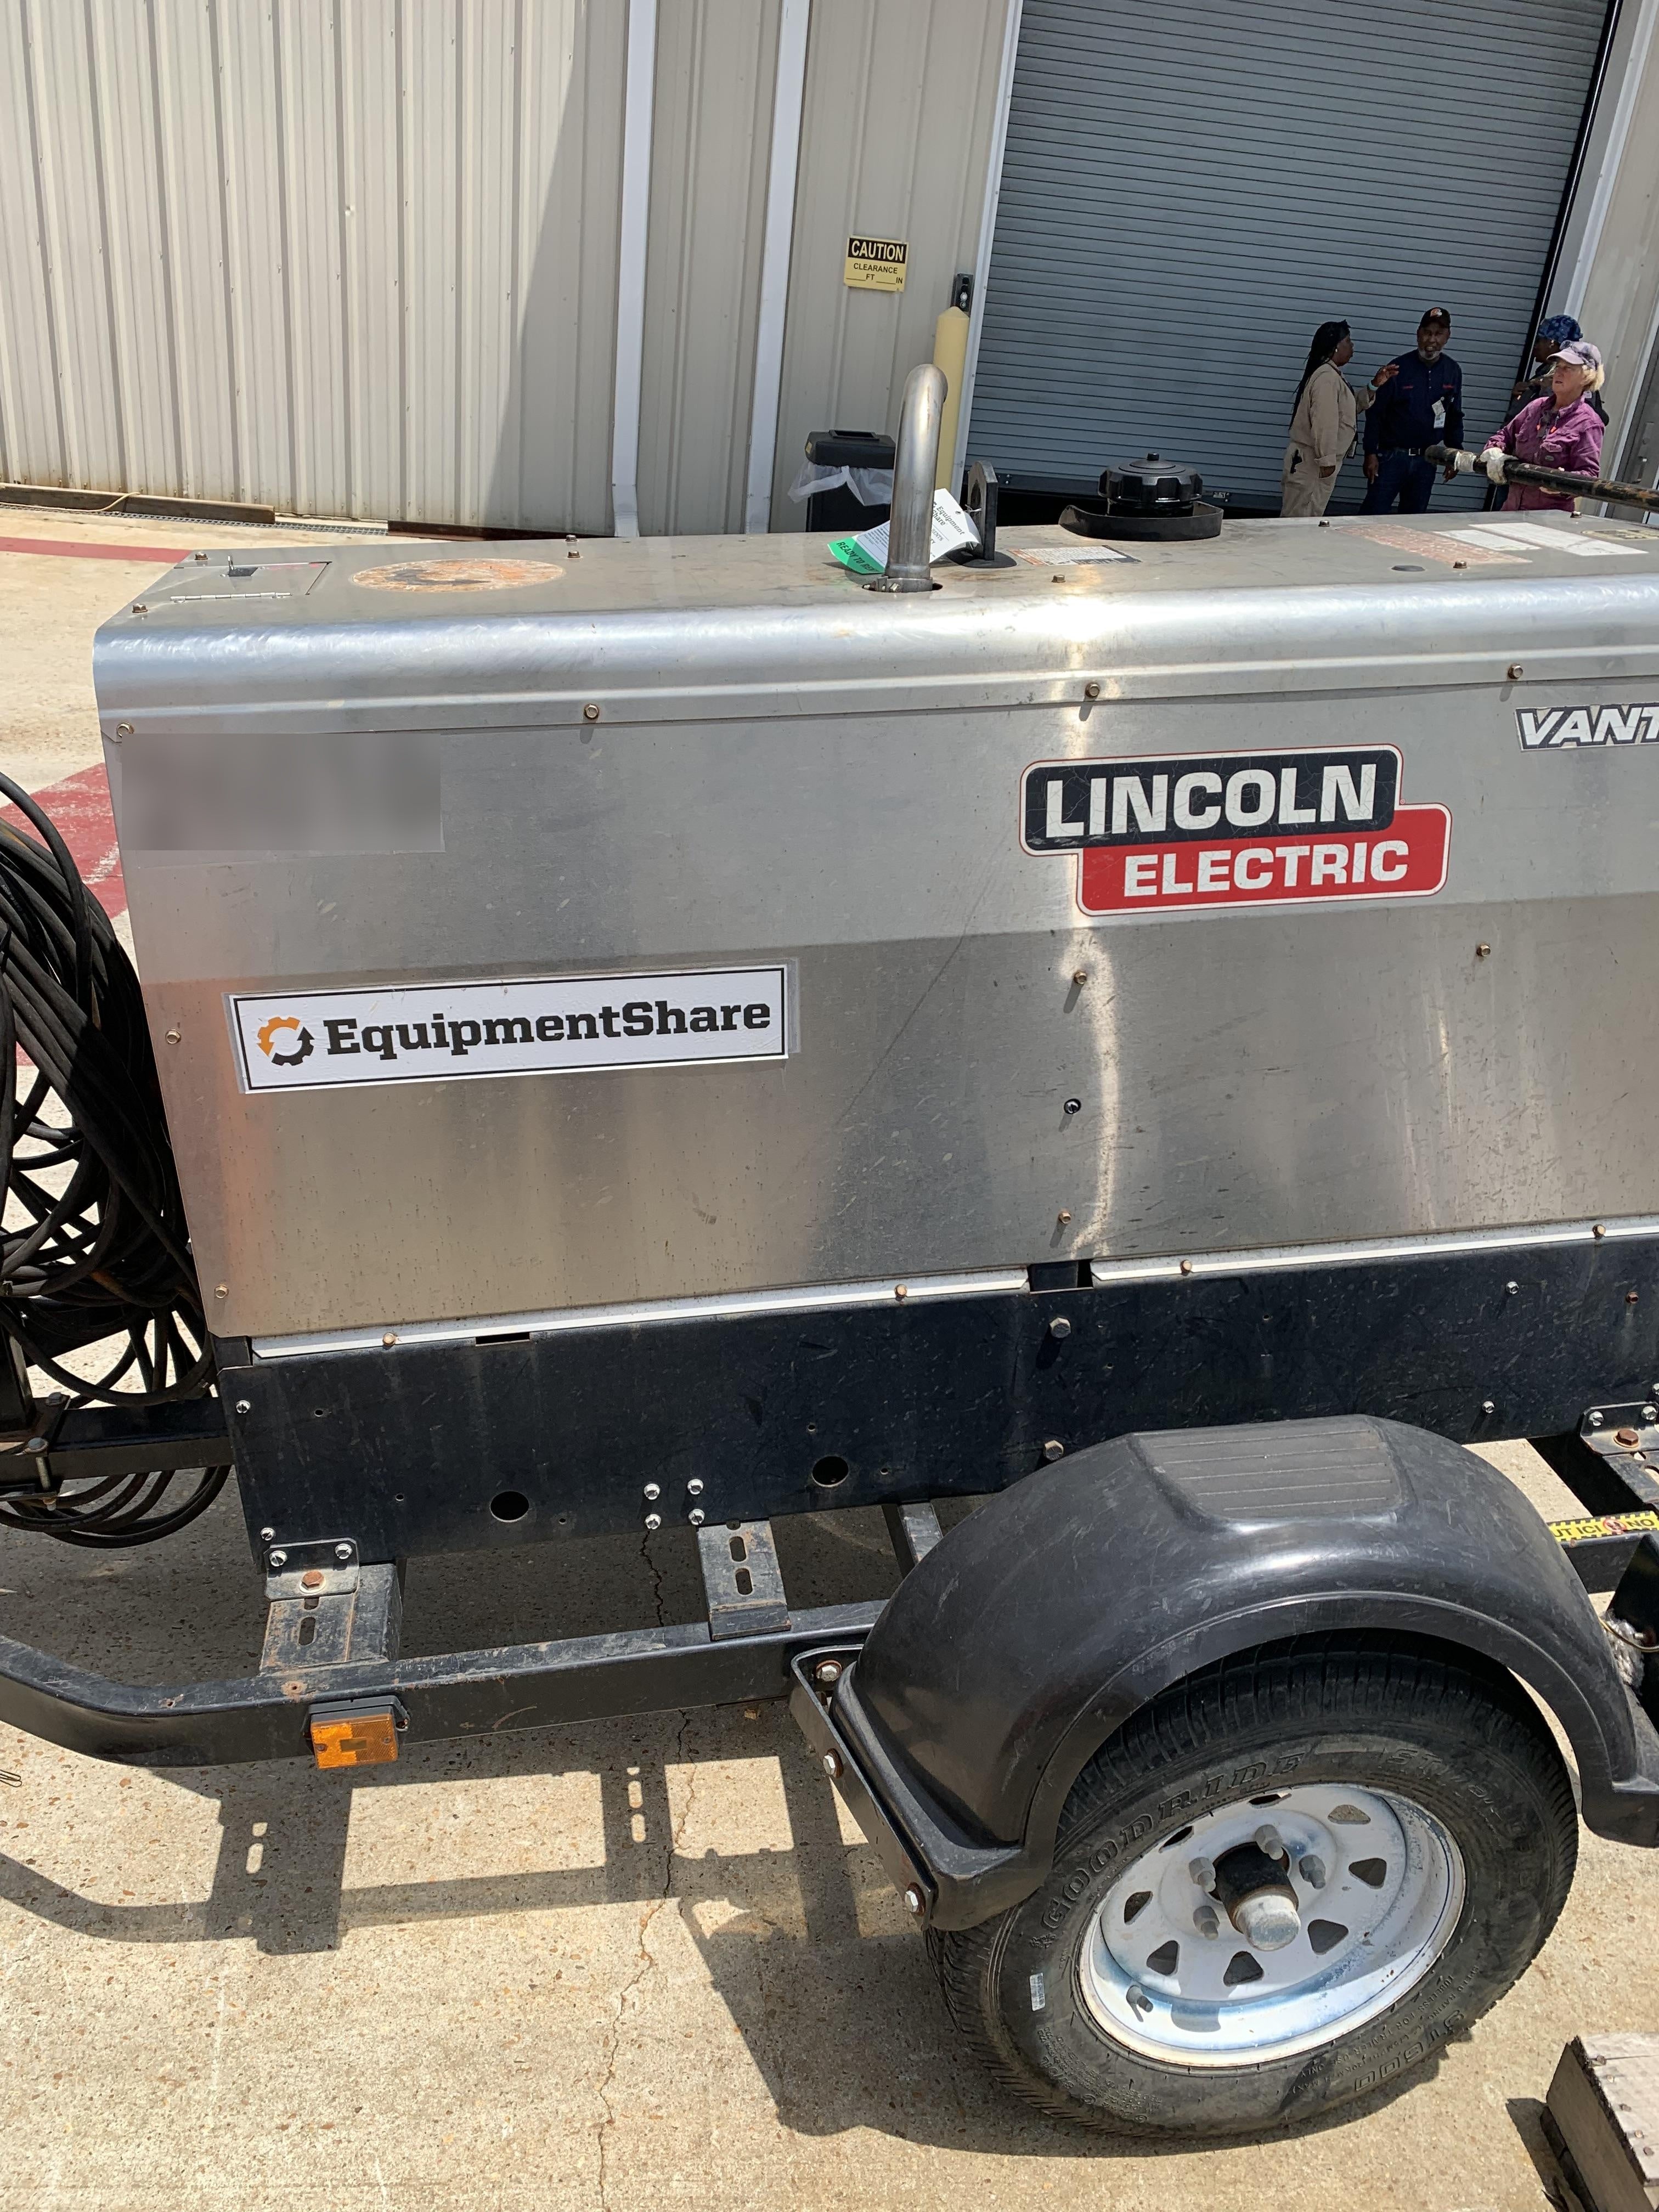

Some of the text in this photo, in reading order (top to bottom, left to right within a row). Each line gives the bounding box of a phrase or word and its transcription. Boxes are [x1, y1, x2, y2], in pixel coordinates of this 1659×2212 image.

[851, 240, 904, 262] CAUTION
[854, 263, 898, 274] CLEARANCE
[936, 506, 965, 535] Equipment
[836, 541, 859, 558] READY
[853, 556, 865, 565] TO
[1045, 763, 1377, 838] LINCOLN
[1124, 840, 1409, 897] ELECTRIC
[323, 1001, 770, 1060] EquipmentShare
[1576, 1525, 1603, 1534] ICI
[1626, 1519, 1655, 1527] NO
[1041, 1752, 1306, 1929] GOODRIDE
